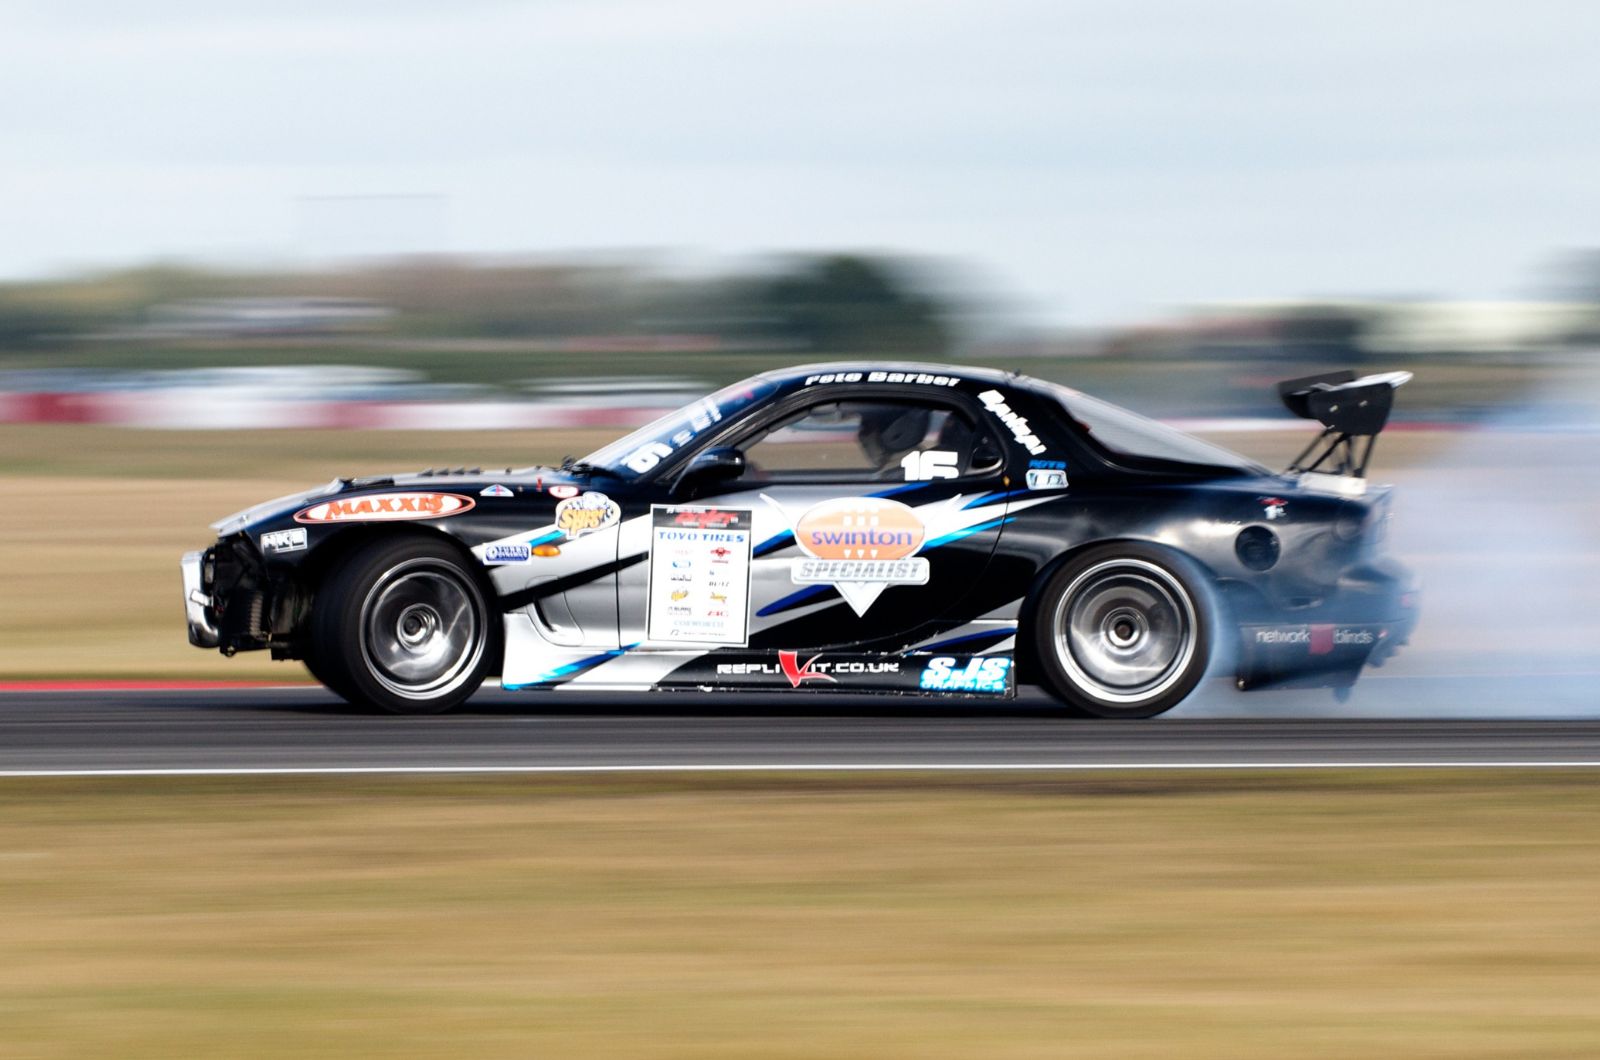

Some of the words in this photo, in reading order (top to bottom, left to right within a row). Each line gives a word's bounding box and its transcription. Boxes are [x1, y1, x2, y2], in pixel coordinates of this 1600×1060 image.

[900, 450, 960, 481] 16
[324, 493, 444, 521] MAXXIS
[659, 531, 698, 541] TOYO
[702, 533, 745, 543] TIRES
[811, 528, 912, 546] swinton
[799, 561, 922, 578] SPECIALIST
[1255, 628, 1311, 644] network
[1334, 628, 1374, 644] blinds
[922, 656, 1011, 681] SJS
